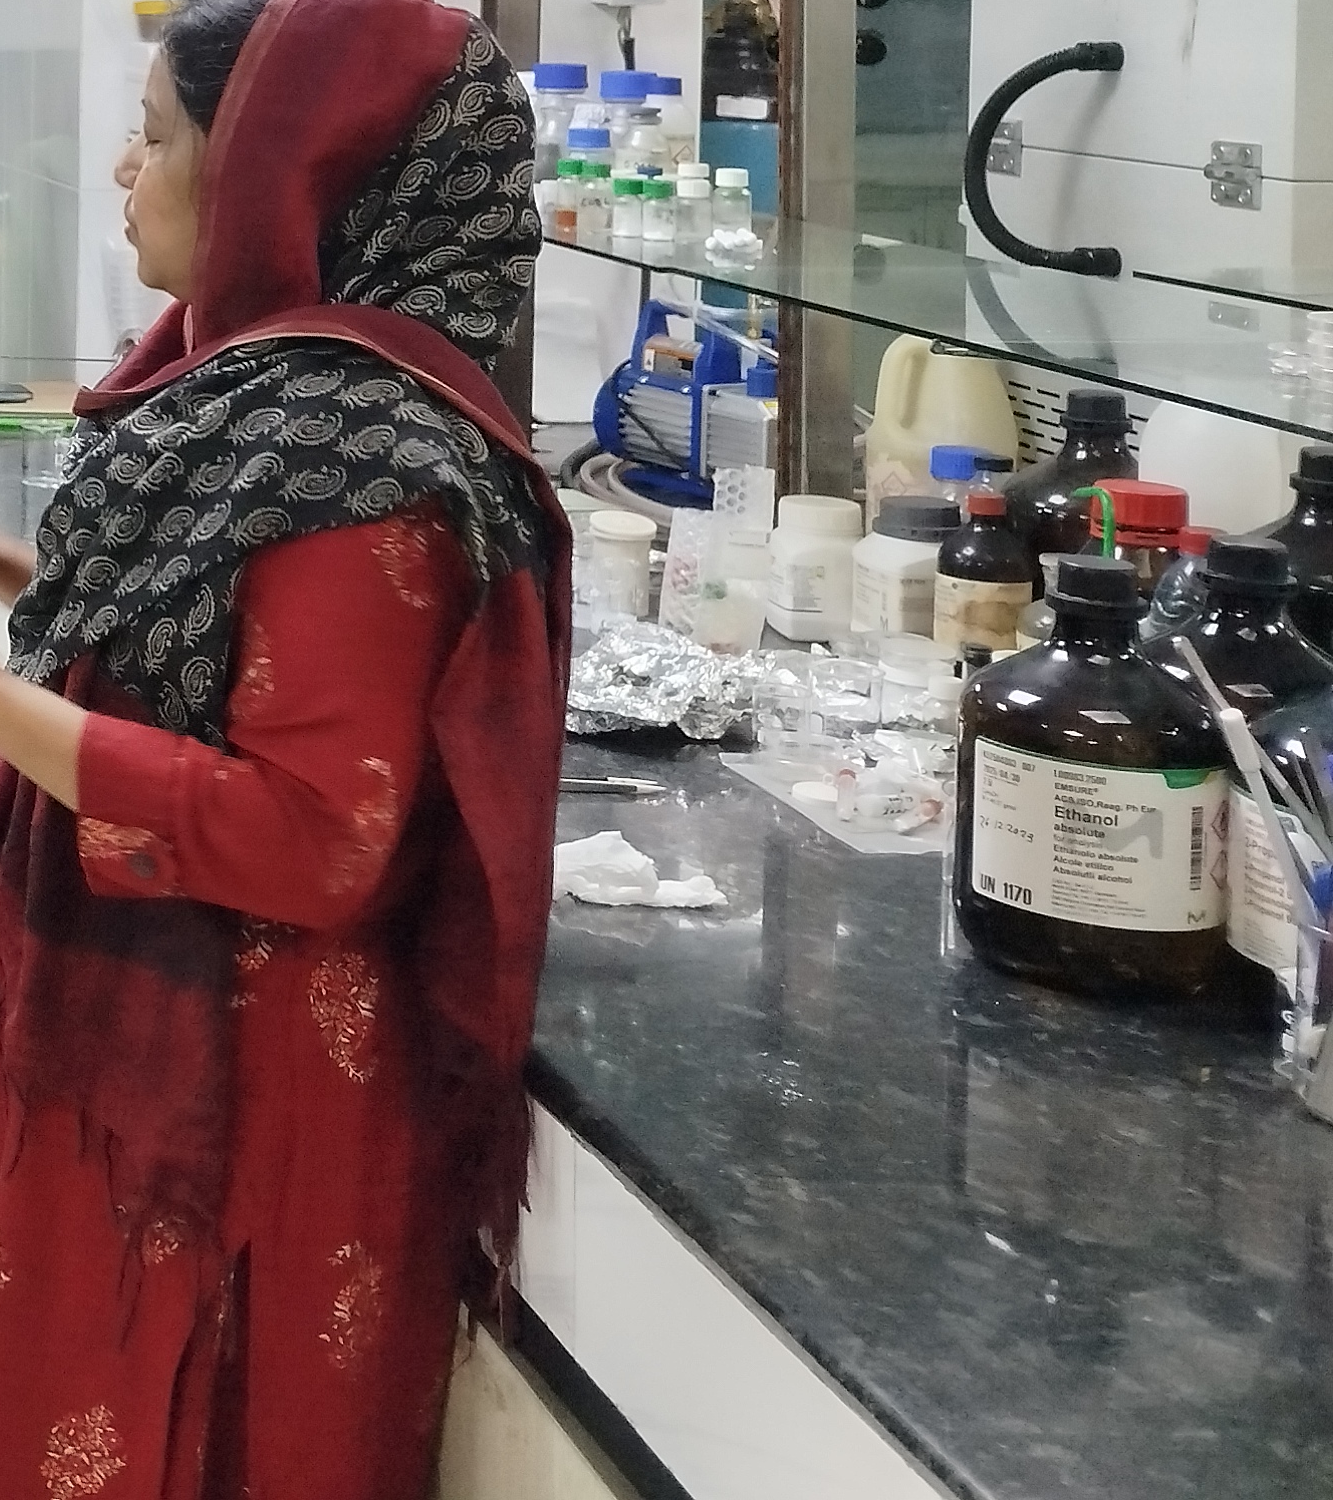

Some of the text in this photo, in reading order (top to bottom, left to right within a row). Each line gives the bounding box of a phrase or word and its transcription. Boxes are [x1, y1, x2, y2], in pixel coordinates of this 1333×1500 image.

[1054, 805, 1118, 827] Ethanol
[1053, 822, 1106, 839] absolute
[980, 873, 996, 894] UN
[1003, 882, 1033, 905] 1170
